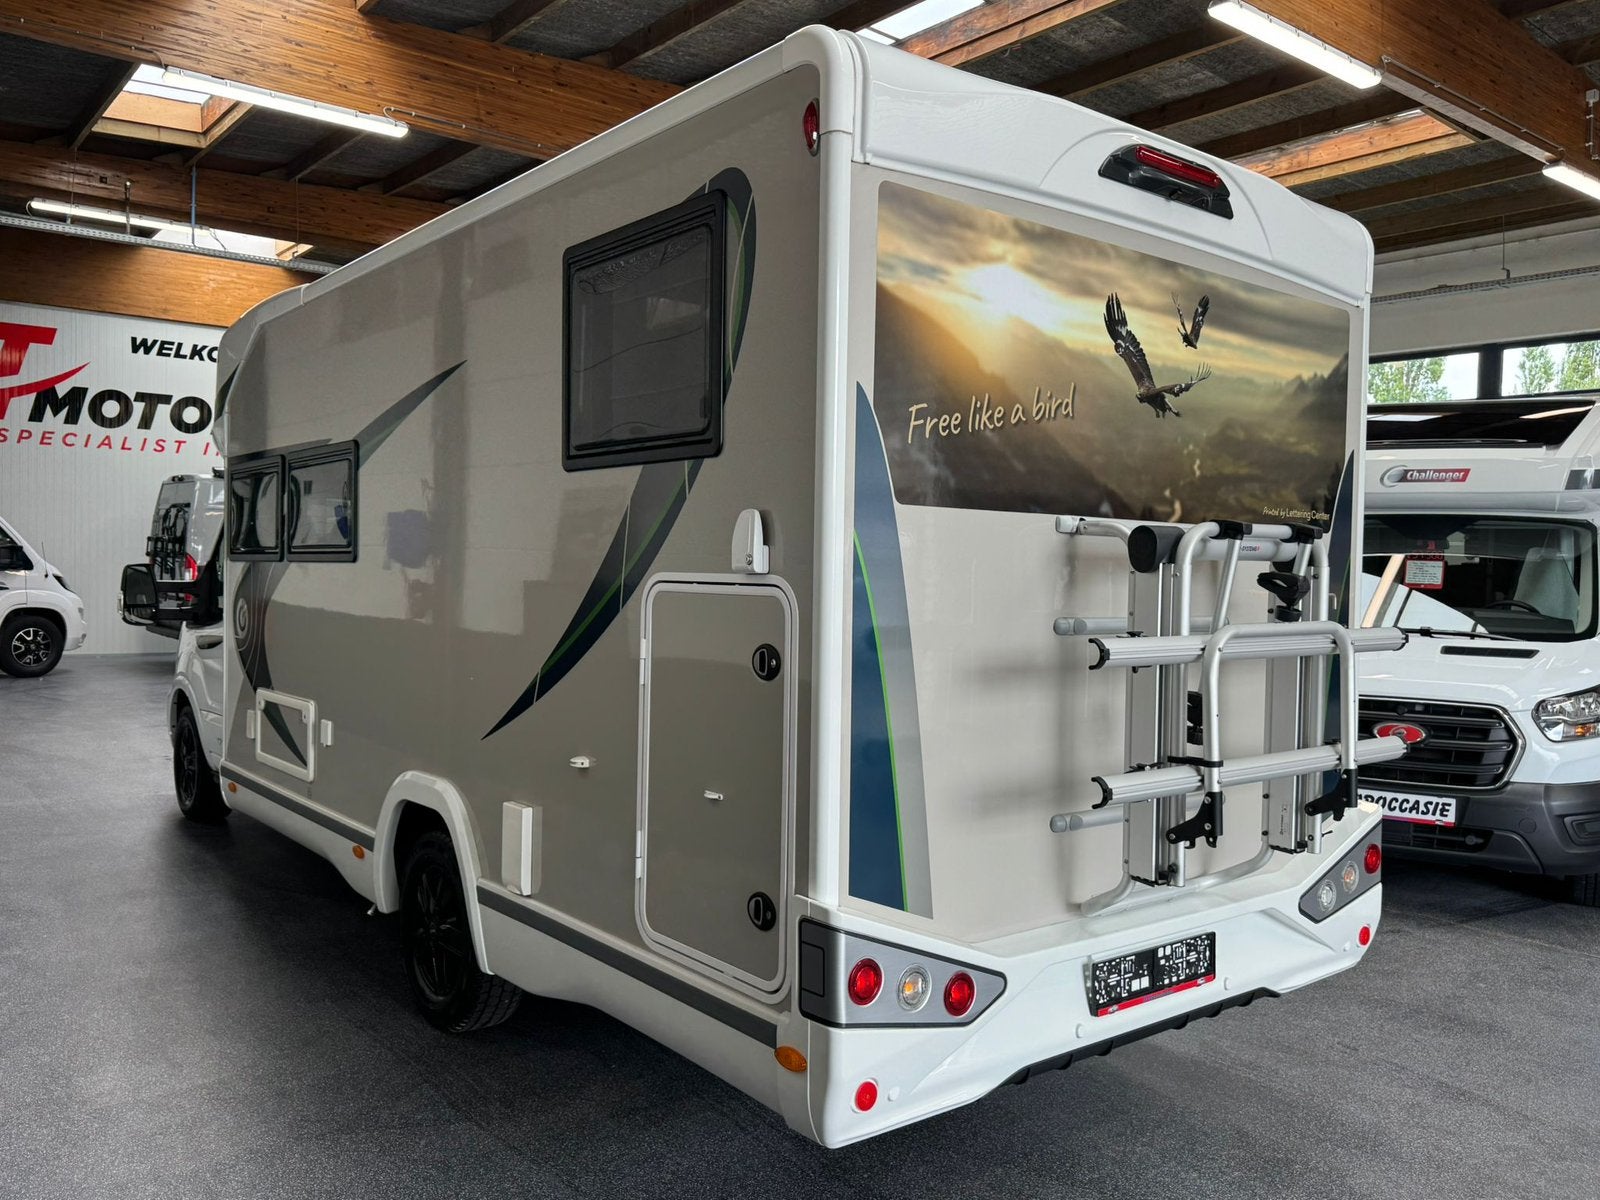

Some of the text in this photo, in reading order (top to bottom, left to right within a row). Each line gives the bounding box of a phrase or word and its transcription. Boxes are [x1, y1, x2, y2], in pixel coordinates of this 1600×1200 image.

[908, 382, 1075, 444] Free like a bird
[0, 428, 187, 455] SPECIALIST
[1406, 470, 1465, 482] Challenger
[1286, 508, 1311, 521] Lettering
[1311, 510, 1331, 521] Center
